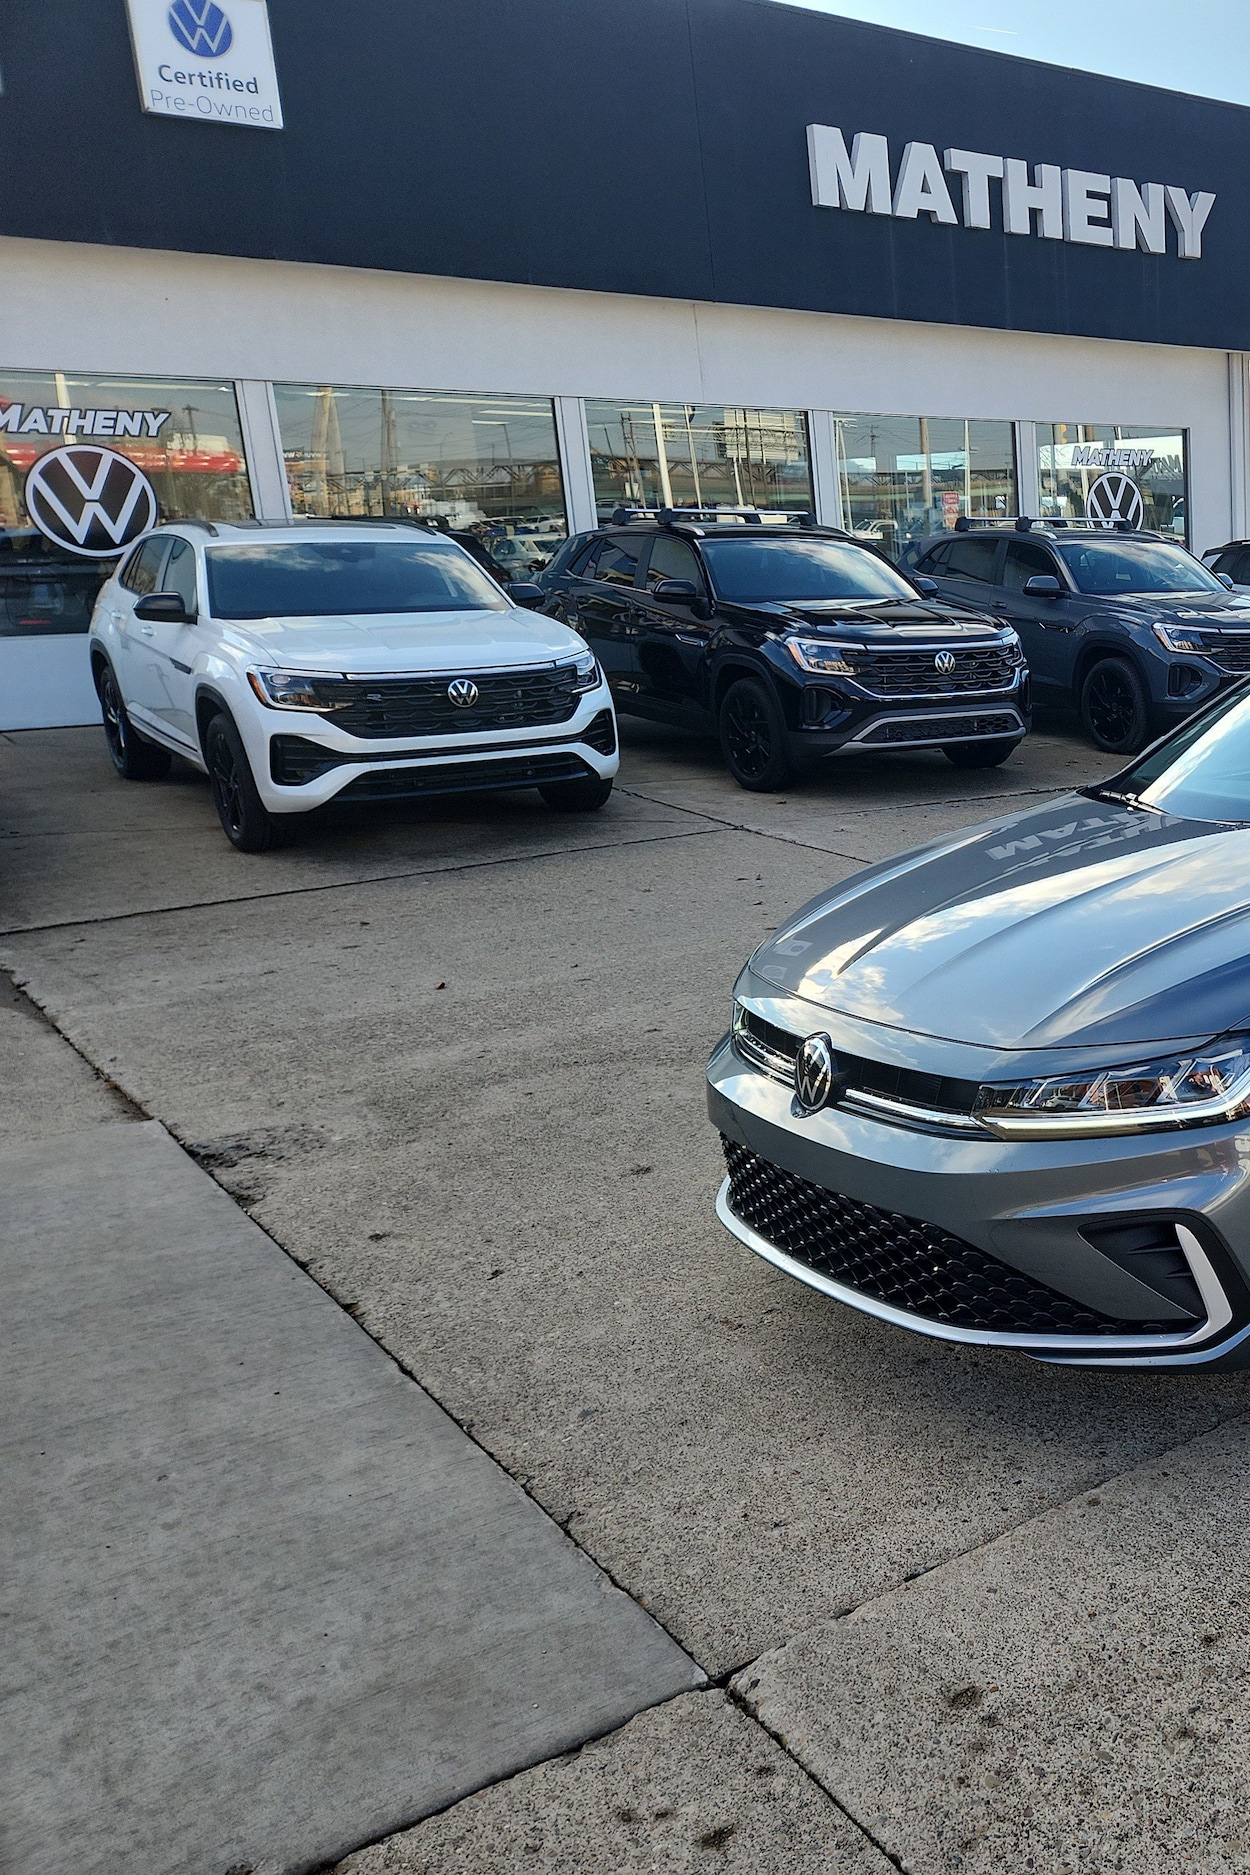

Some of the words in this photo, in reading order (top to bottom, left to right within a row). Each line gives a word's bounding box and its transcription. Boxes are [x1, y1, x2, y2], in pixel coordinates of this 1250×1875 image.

[158, 64, 260, 95] Certified
[150, 89, 274, 122] Pre-Owned
[805, 123, 1217, 259] MATHENY
[1070, 445, 1155, 467] MATHENY
[29, 447, 154, 554] VW
